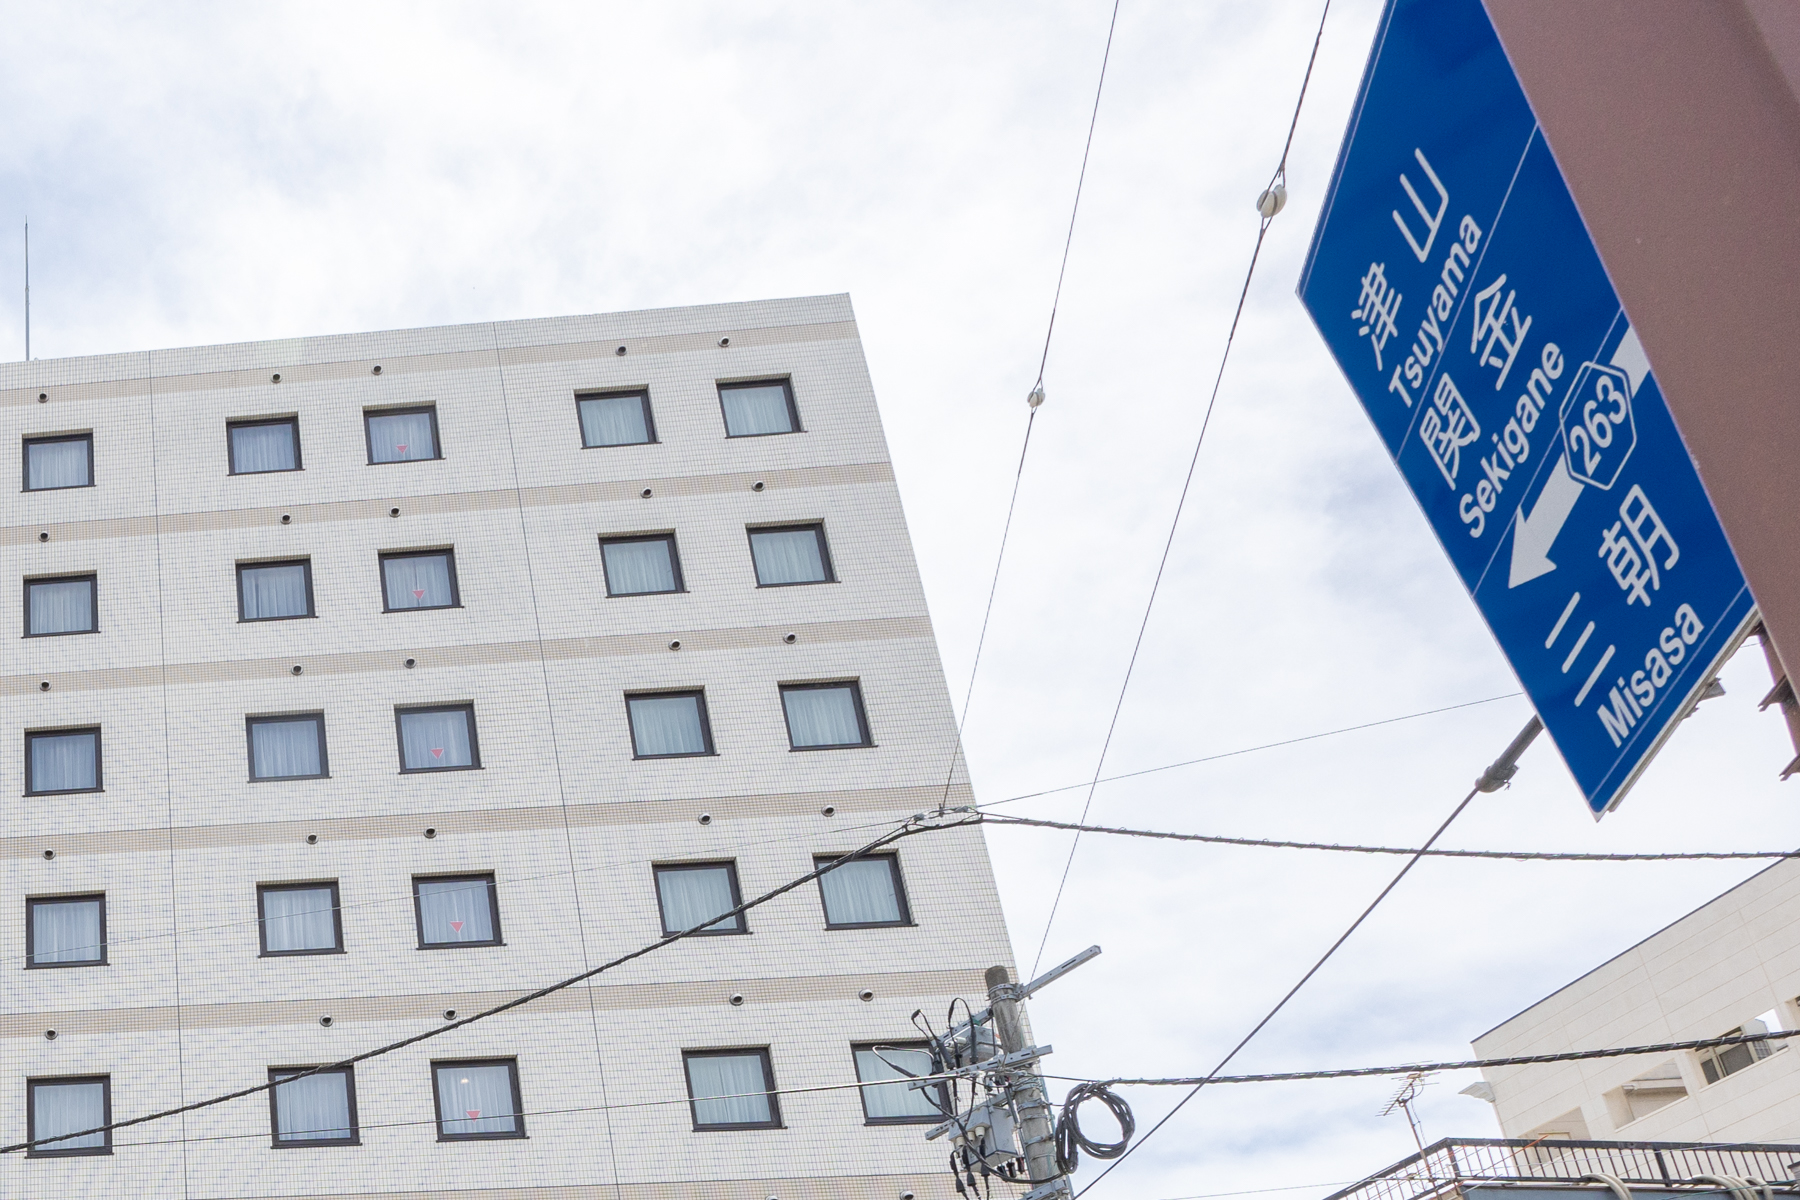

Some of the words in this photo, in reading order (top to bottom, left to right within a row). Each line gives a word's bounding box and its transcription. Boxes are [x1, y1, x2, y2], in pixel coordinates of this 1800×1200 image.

[1351, 147, 1450, 371] 津山
[1389, 213, 1483, 409] Tsuyama
[1419, 273, 1533, 492] 関金
[1458, 340, 1565, 540] Sekigane
[1570, 373, 1628, 476] 263
[1545, 482, 1681, 707] 三朝
[1596, 600, 1706, 750] Misasa
